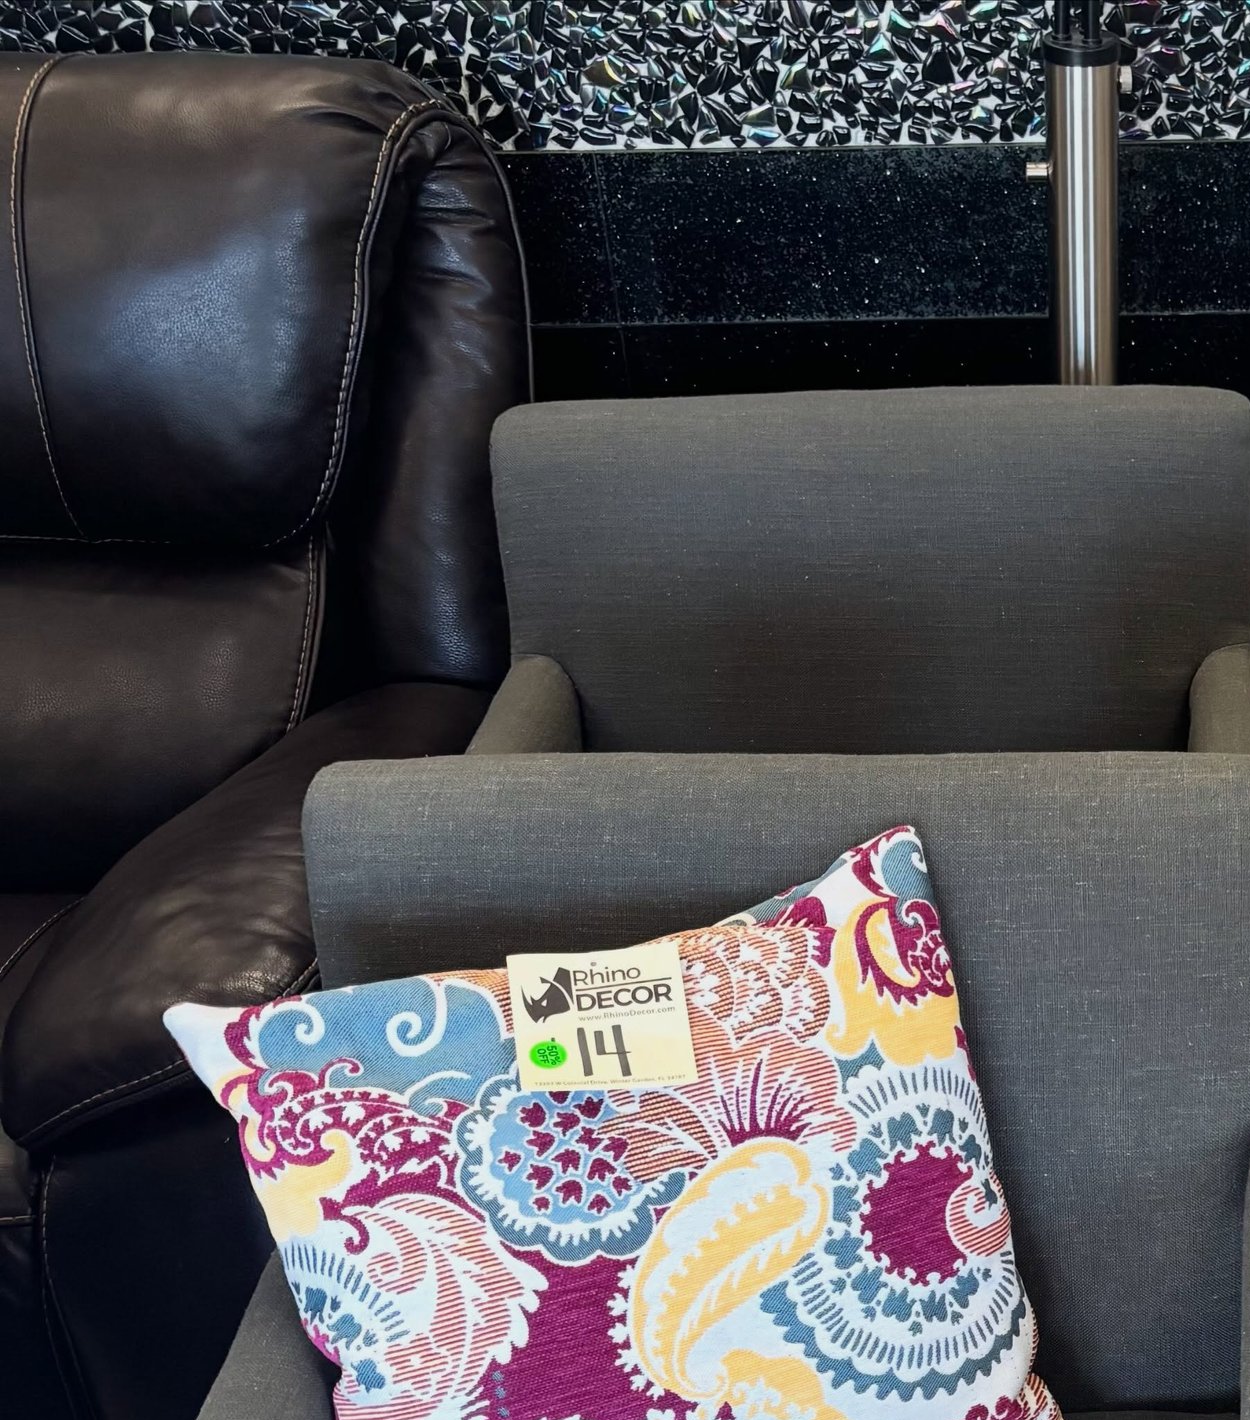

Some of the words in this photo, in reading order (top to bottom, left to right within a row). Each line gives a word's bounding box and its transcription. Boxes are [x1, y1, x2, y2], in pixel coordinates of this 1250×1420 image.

[572, 966, 641, 986] Rhino
[575, 983, 673, 1012] DECOR
[578, 1006, 676, 1022] www.RhinoDecor.com
[537, 1048, 549, 1064] OFF
[546, 1045, 561, 1065] 50%
[577, 1024, 632, 1077] 14
